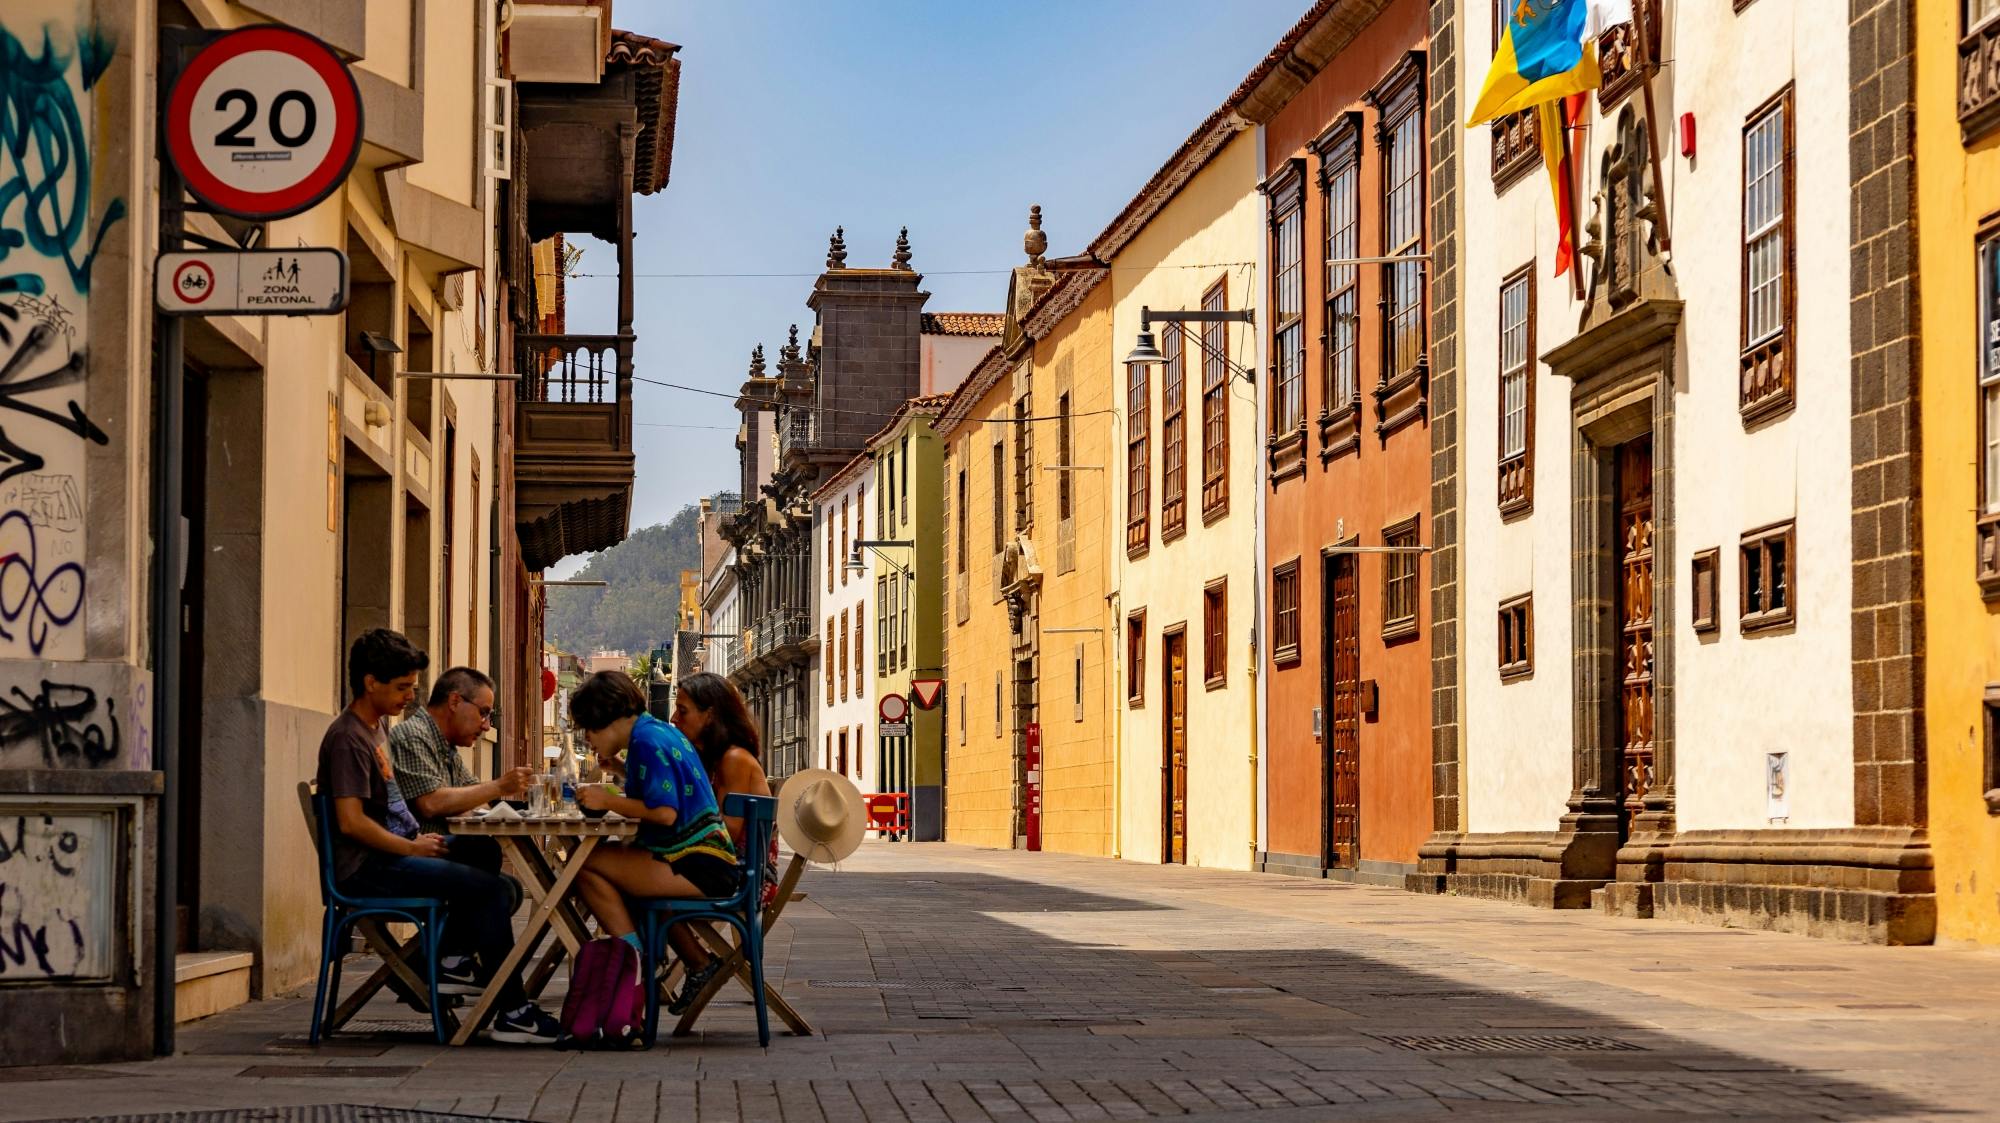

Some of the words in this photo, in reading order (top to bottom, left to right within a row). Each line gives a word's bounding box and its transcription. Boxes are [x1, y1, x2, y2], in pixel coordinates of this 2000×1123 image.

[215, 88, 317, 148] 20
[263, 285, 300, 294] ZONA
[247, 295, 315, 304] PEATONAL
